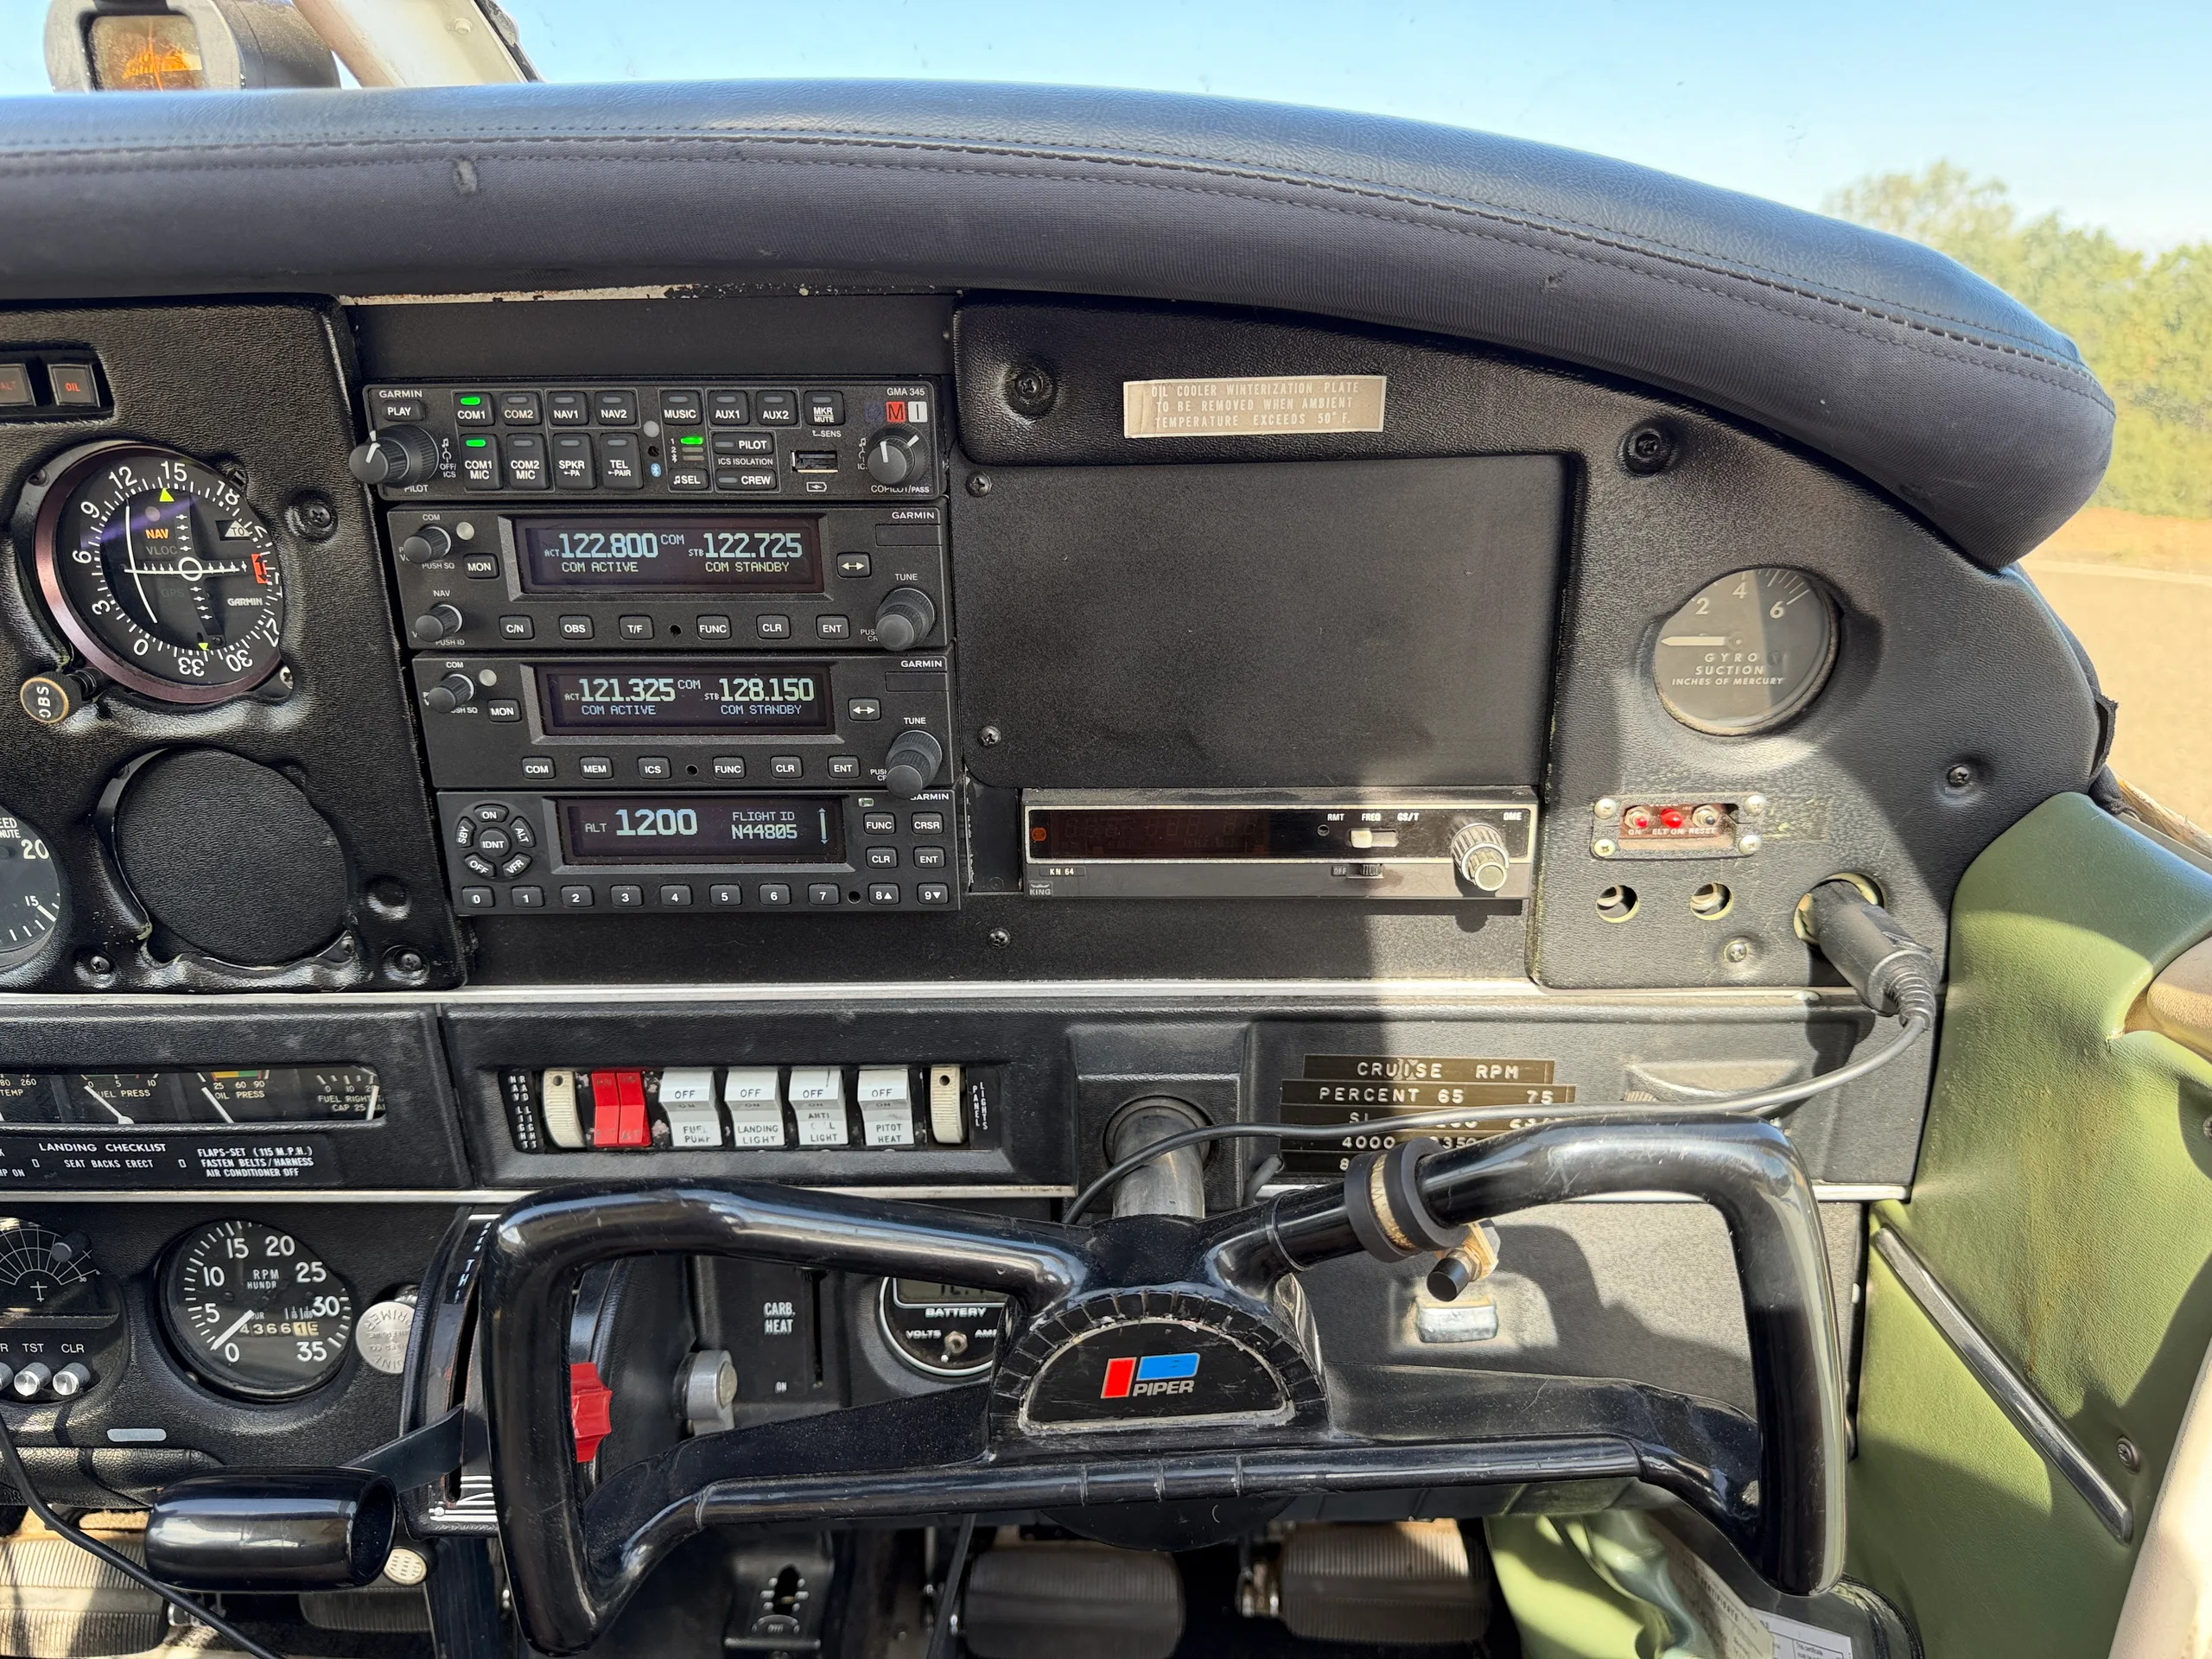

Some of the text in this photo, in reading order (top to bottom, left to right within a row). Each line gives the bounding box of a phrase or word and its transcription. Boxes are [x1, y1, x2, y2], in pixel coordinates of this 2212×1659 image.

[65, 383, 80, 392] OIL
[1151, 382, 1359, 397] OIL COOLER WINTERIZATION PLATE
[1156, 400, 1169, 413] TO
[1178, 400, 1192, 412] BE
[1201, 399, 1254, 412] REMOVED
[1263, 398, 1294, 410] WHEN
[387, 407, 411, 416] PLAY
[457, 410, 486, 420] COM1
[505, 410, 534, 419] COM2
[554, 410, 579, 419] NAV1
[601, 410, 627, 419] NAV2
[664, 410, 696, 419] MUSIC
[715, 410, 740, 419] AUX1
[762, 410, 789, 420] AUX2
[813, 407, 833, 416] MKR
[1155, 413, 1306, 429] TEMPERATURE EXCEEDS
[739, 440, 767, 450] PILOT
[465, 461, 493, 469] COM1
[511, 460, 539, 469] COM2
[559, 460, 585, 469] SPKR
[610, 460, 628, 468] TEL
[161, 461, 188, 481] 15
[470, 470, 489, 480] MIC
[516, 470, 536, 480] MIC
[109, 466, 138, 488] 12
[741, 476, 771, 486] CREW
[145, 529, 169, 539] NAV
[660, 534, 684, 545] COM
[146, 545, 177, 555] VLOC
[544, 533, 658, 558] ACT 122.800
[688, 533, 803, 558] STB 122.725
[467, 563, 491, 572] MON
[562, 562, 639, 572] COM ACTIVE
[705, 562, 789, 572] COM STANDBY
[1732, 582, 1747, 599] 4
[1695, 598, 1710, 615] 2
[1770, 601, 1785, 619] 6
[506, 624, 524, 633] C/N
[564, 624, 586, 633] OBS
[627, 625, 643, 633] T/F
[699, 625, 727, 634] FUNC
[762, 623, 782, 632] CLR
[823, 625, 842, 633] ENT
[1704, 652, 1759, 663] GYRO
[1694, 664, 1764, 676] SUCTION
[579, 678, 676, 702] 121.325
[677, 680, 701, 690] COM
[719, 678, 814, 702] 128.150
[491, 708, 514, 716] MON
[582, 705, 656, 715] COM ACTIVE
[721, 705, 802, 715] COM STANDBY
[525, 766, 549, 774] COM
[583, 765, 607, 773] MEM
[645, 766, 661, 774] ICS
[715, 765, 741, 774] FUNC
[775, 764, 794, 773] CLR
[834, 764, 853, 772] ENT
[482, 811, 497, 820] ON
[733, 811, 795, 821] FLIGHT ID
[1397, 813, 1420, 822] GS/T
[584, 809, 697, 836] ALT 1200
[457, 826, 469, 843] SBY
[515, 828, 529, 843] ALT
[731, 824, 798, 840] N44805
[21, 839, 49, 859] 20
[469, 861, 489, 874] OFF
[505, 859, 524, 874] VFR
[24, 896, 39, 906] 15
[1357, 1062, 1519, 1079] CRUISE RPM
[675, 1090, 696, 1099] OFF
[741, 1089, 761, 1097] OFF
[1319, 1087, 1554, 1105] PERCENT 65 75
[878, 1135, 901, 1143] HEAT
[1342, 1136, 1395, 1149] 4000
[39, 1143, 167, 1152] LANDING CHECKLIST
[226, 1238, 249, 1259] 15
[265, 1236, 295, 1256] 20
[203, 1267, 225, 1287] 10
[253, 1269, 279, 1279] RPM
[296, 1262, 327, 1282] 25
[247, 1281, 276, 1289] HUNDR
[312, 1296, 340, 1317] 30
[205, 1303, 221, 1323] 5
[925, 1308, 987, 1318] BATTERY
[765, 1319, 793, 1335] HEAT
[906, 1330, 942, 1339] VOLTS
[22, 1343, 44, 1353] TST
[60, 1343, 85, 1353] CLR
[225, 1343, 239, 1362] 0
[296, 1341, 327, 1362] 35
[1132, 1380, 1195, 1396] PIPER
